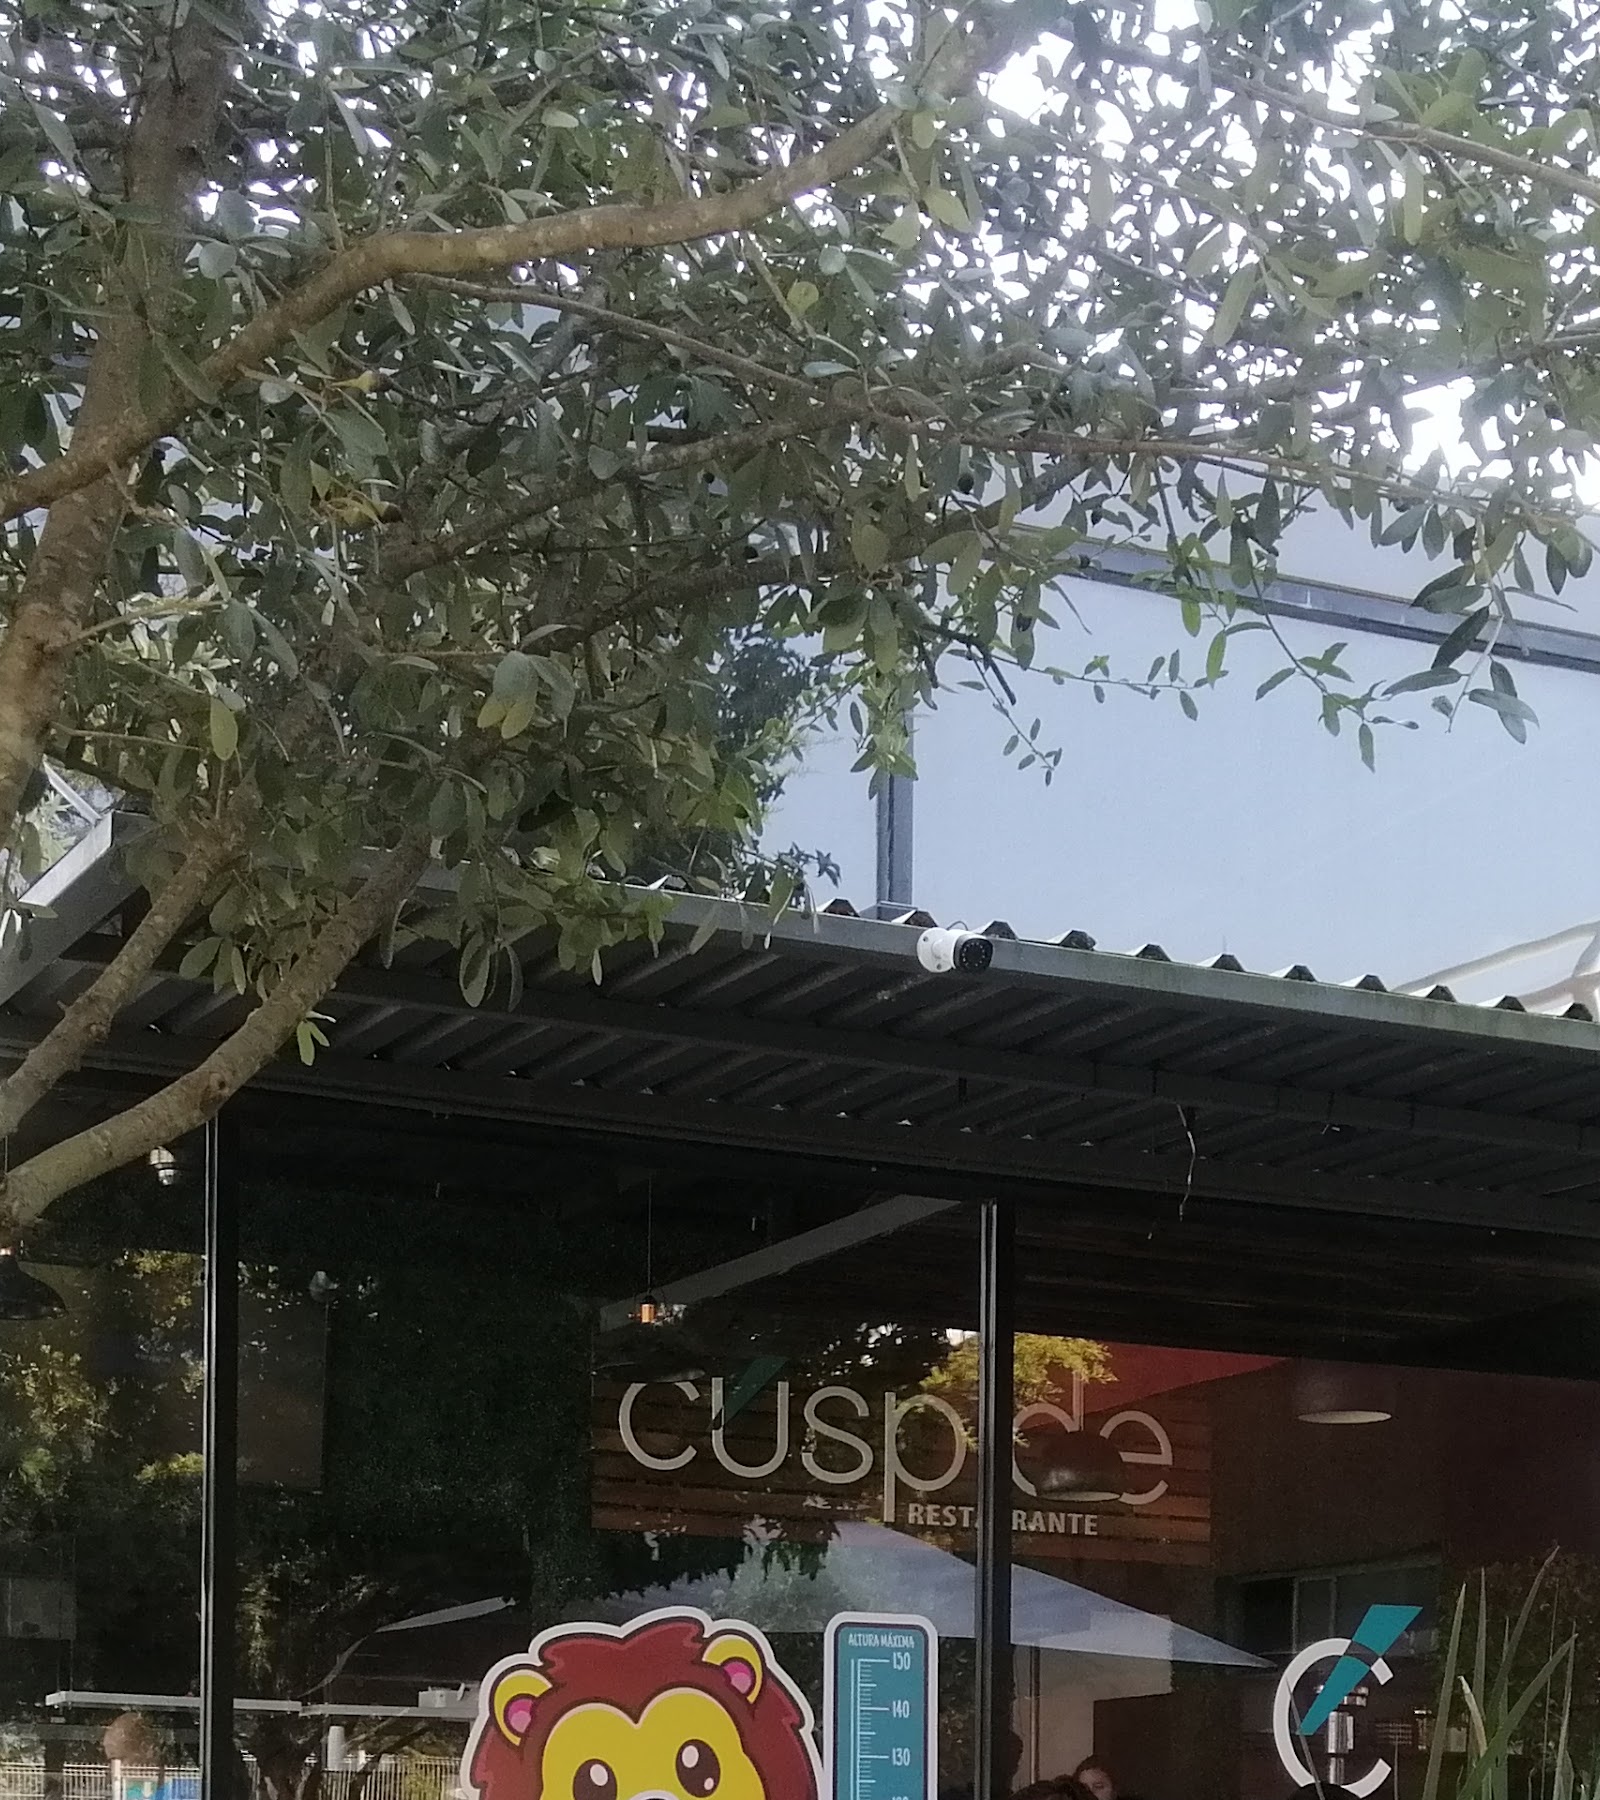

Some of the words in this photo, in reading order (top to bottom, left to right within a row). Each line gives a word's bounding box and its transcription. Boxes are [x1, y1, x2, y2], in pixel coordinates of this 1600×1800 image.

[618, 1355, 1174, 1523] cúspde
[907, 1503, 1099, 1536] RESTRANTE
[848, 1633, 880, 1648] ALTURA
[880, 1632, 915, 1649] MÁXIMA
[892, 1652, 911, 1670] 150
[892, 1700, 910, 1718] 140
[892, 1748, 911, 1766] 130
